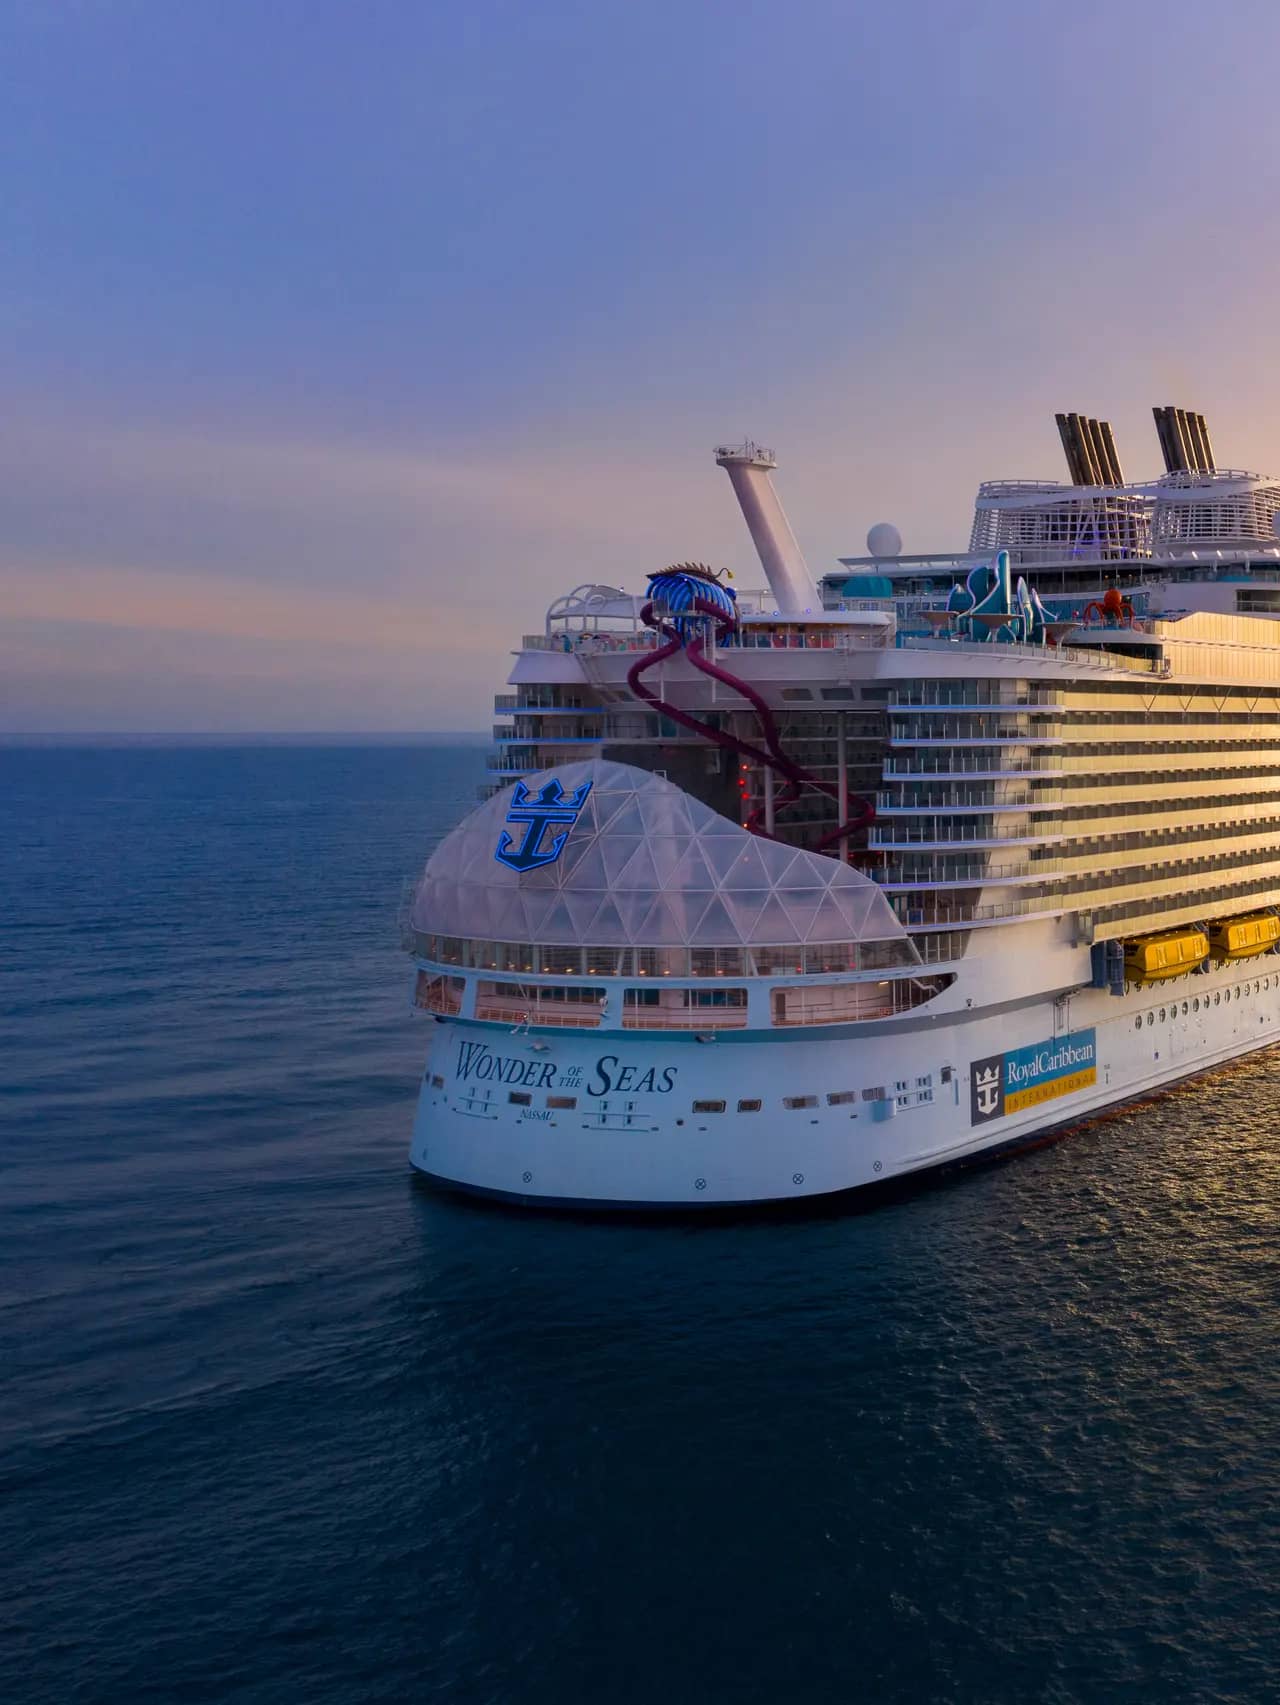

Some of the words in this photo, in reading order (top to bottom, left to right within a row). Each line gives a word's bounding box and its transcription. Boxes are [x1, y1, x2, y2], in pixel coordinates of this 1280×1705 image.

[456, 1040, 557, 1088] WONDER
[559, 1077, 584, 1088] THE
[567, 1066, 584, 1077] OF
[586, 1055, 678, 1097] SEAS
[1008, 1071, 1095, 1110] INTERNATIONAL
